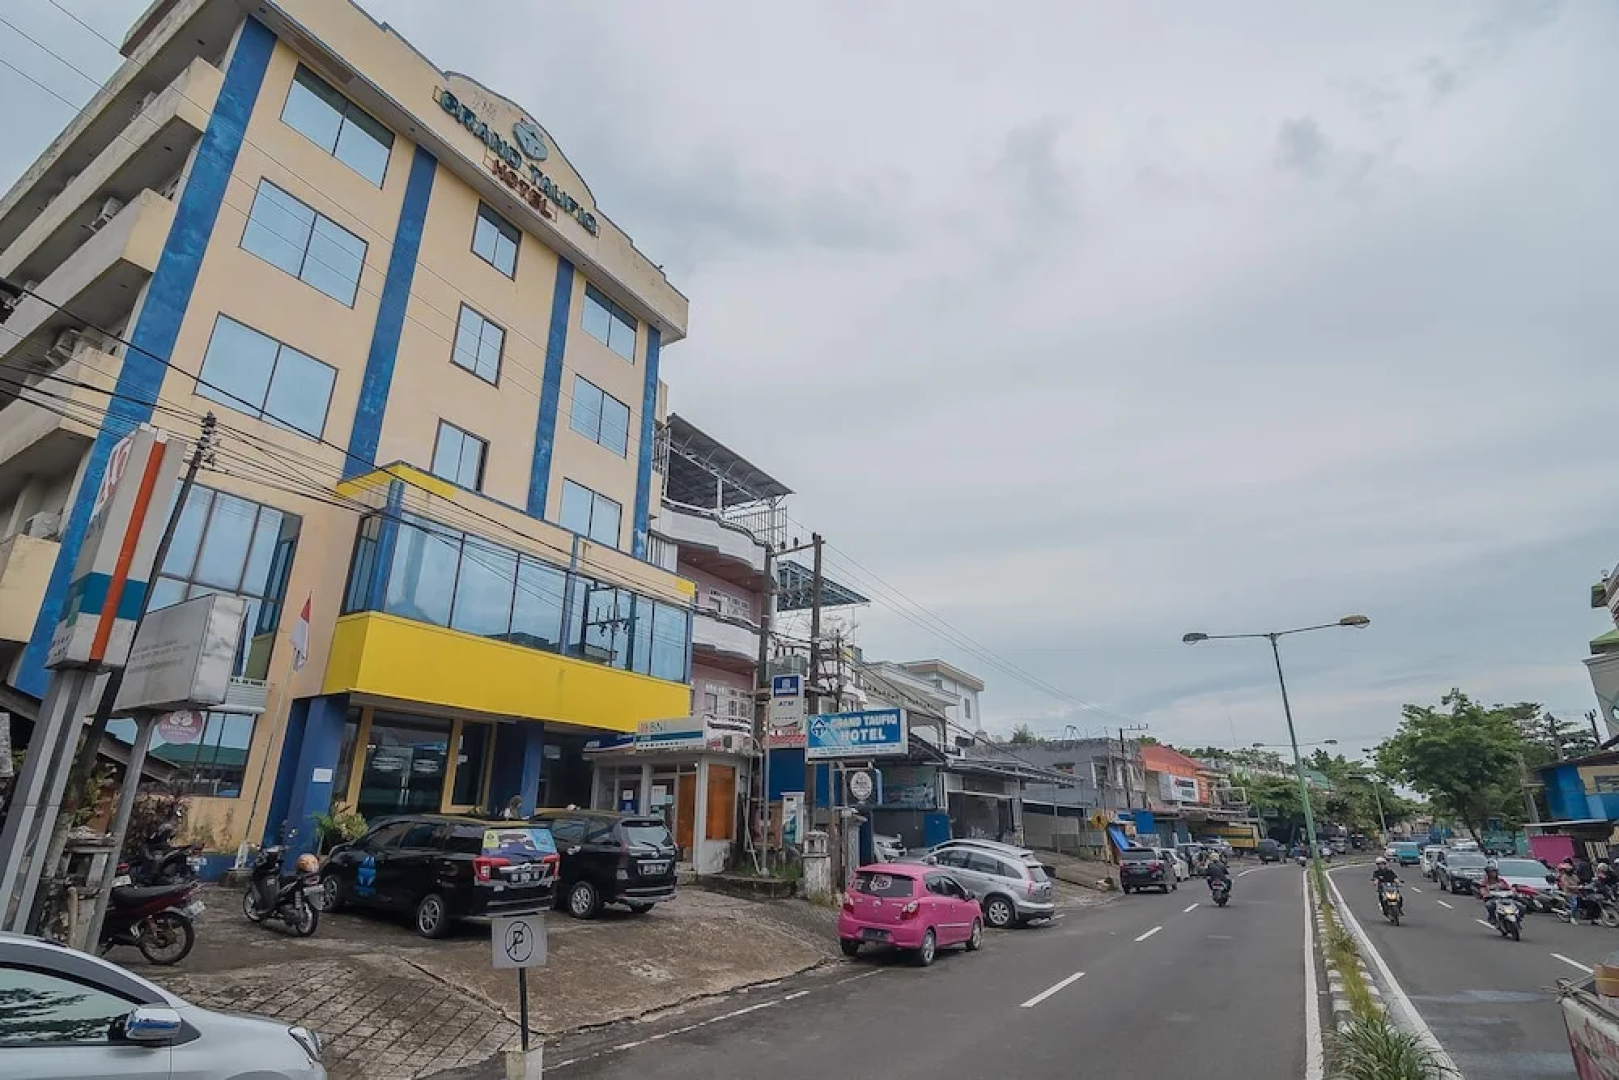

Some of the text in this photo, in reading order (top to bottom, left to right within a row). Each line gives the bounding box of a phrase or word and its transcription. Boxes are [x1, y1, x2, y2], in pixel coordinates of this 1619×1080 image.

[440, 90, 522, 170] GRAND
[491, 159, 552, 219] HOTEL
[841, 728, 886, 741] HOTEL
